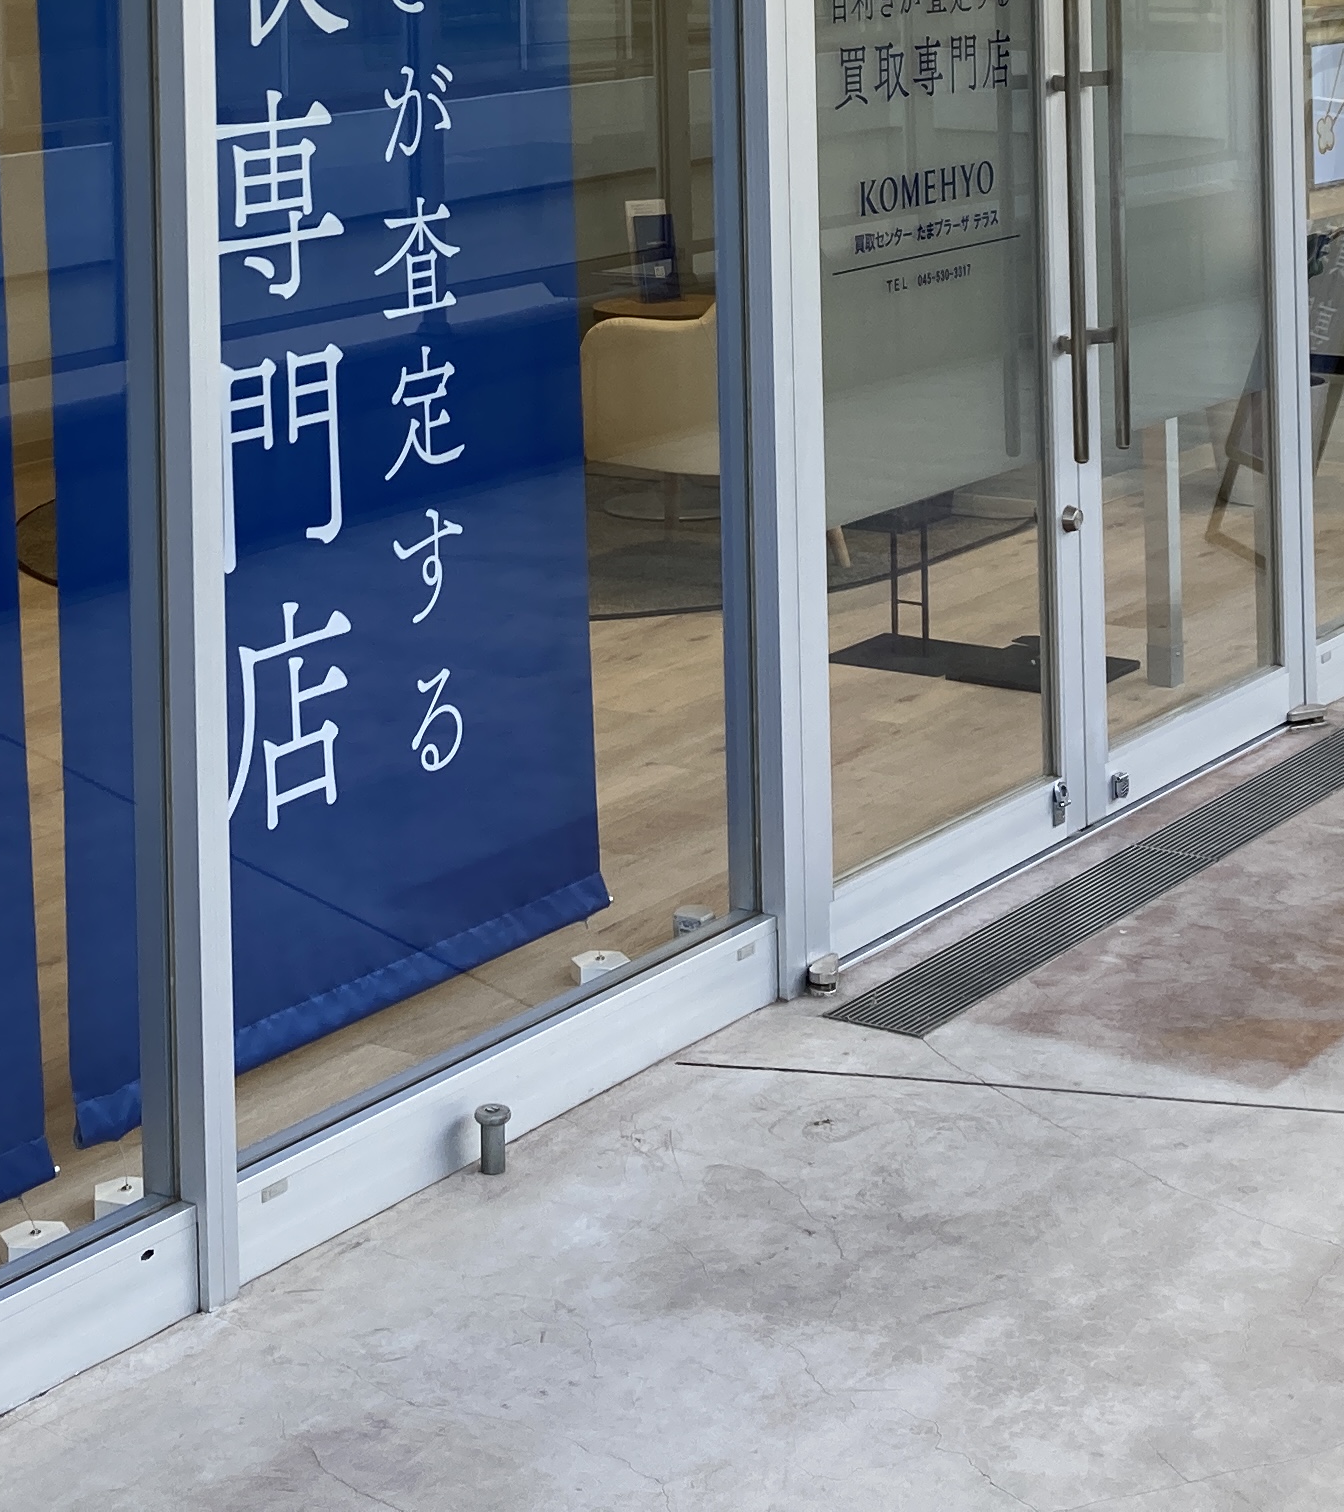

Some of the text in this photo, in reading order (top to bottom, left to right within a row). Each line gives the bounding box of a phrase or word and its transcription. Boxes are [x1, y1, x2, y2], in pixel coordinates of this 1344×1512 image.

[834, 29, 1012, 111] 買取専門店
[859, 160, 995, 218] KOMEHYO
[854, 209, 999, 255] 買取センター たまプラーザ テラス
[886, 276, 908, 294] TEL
